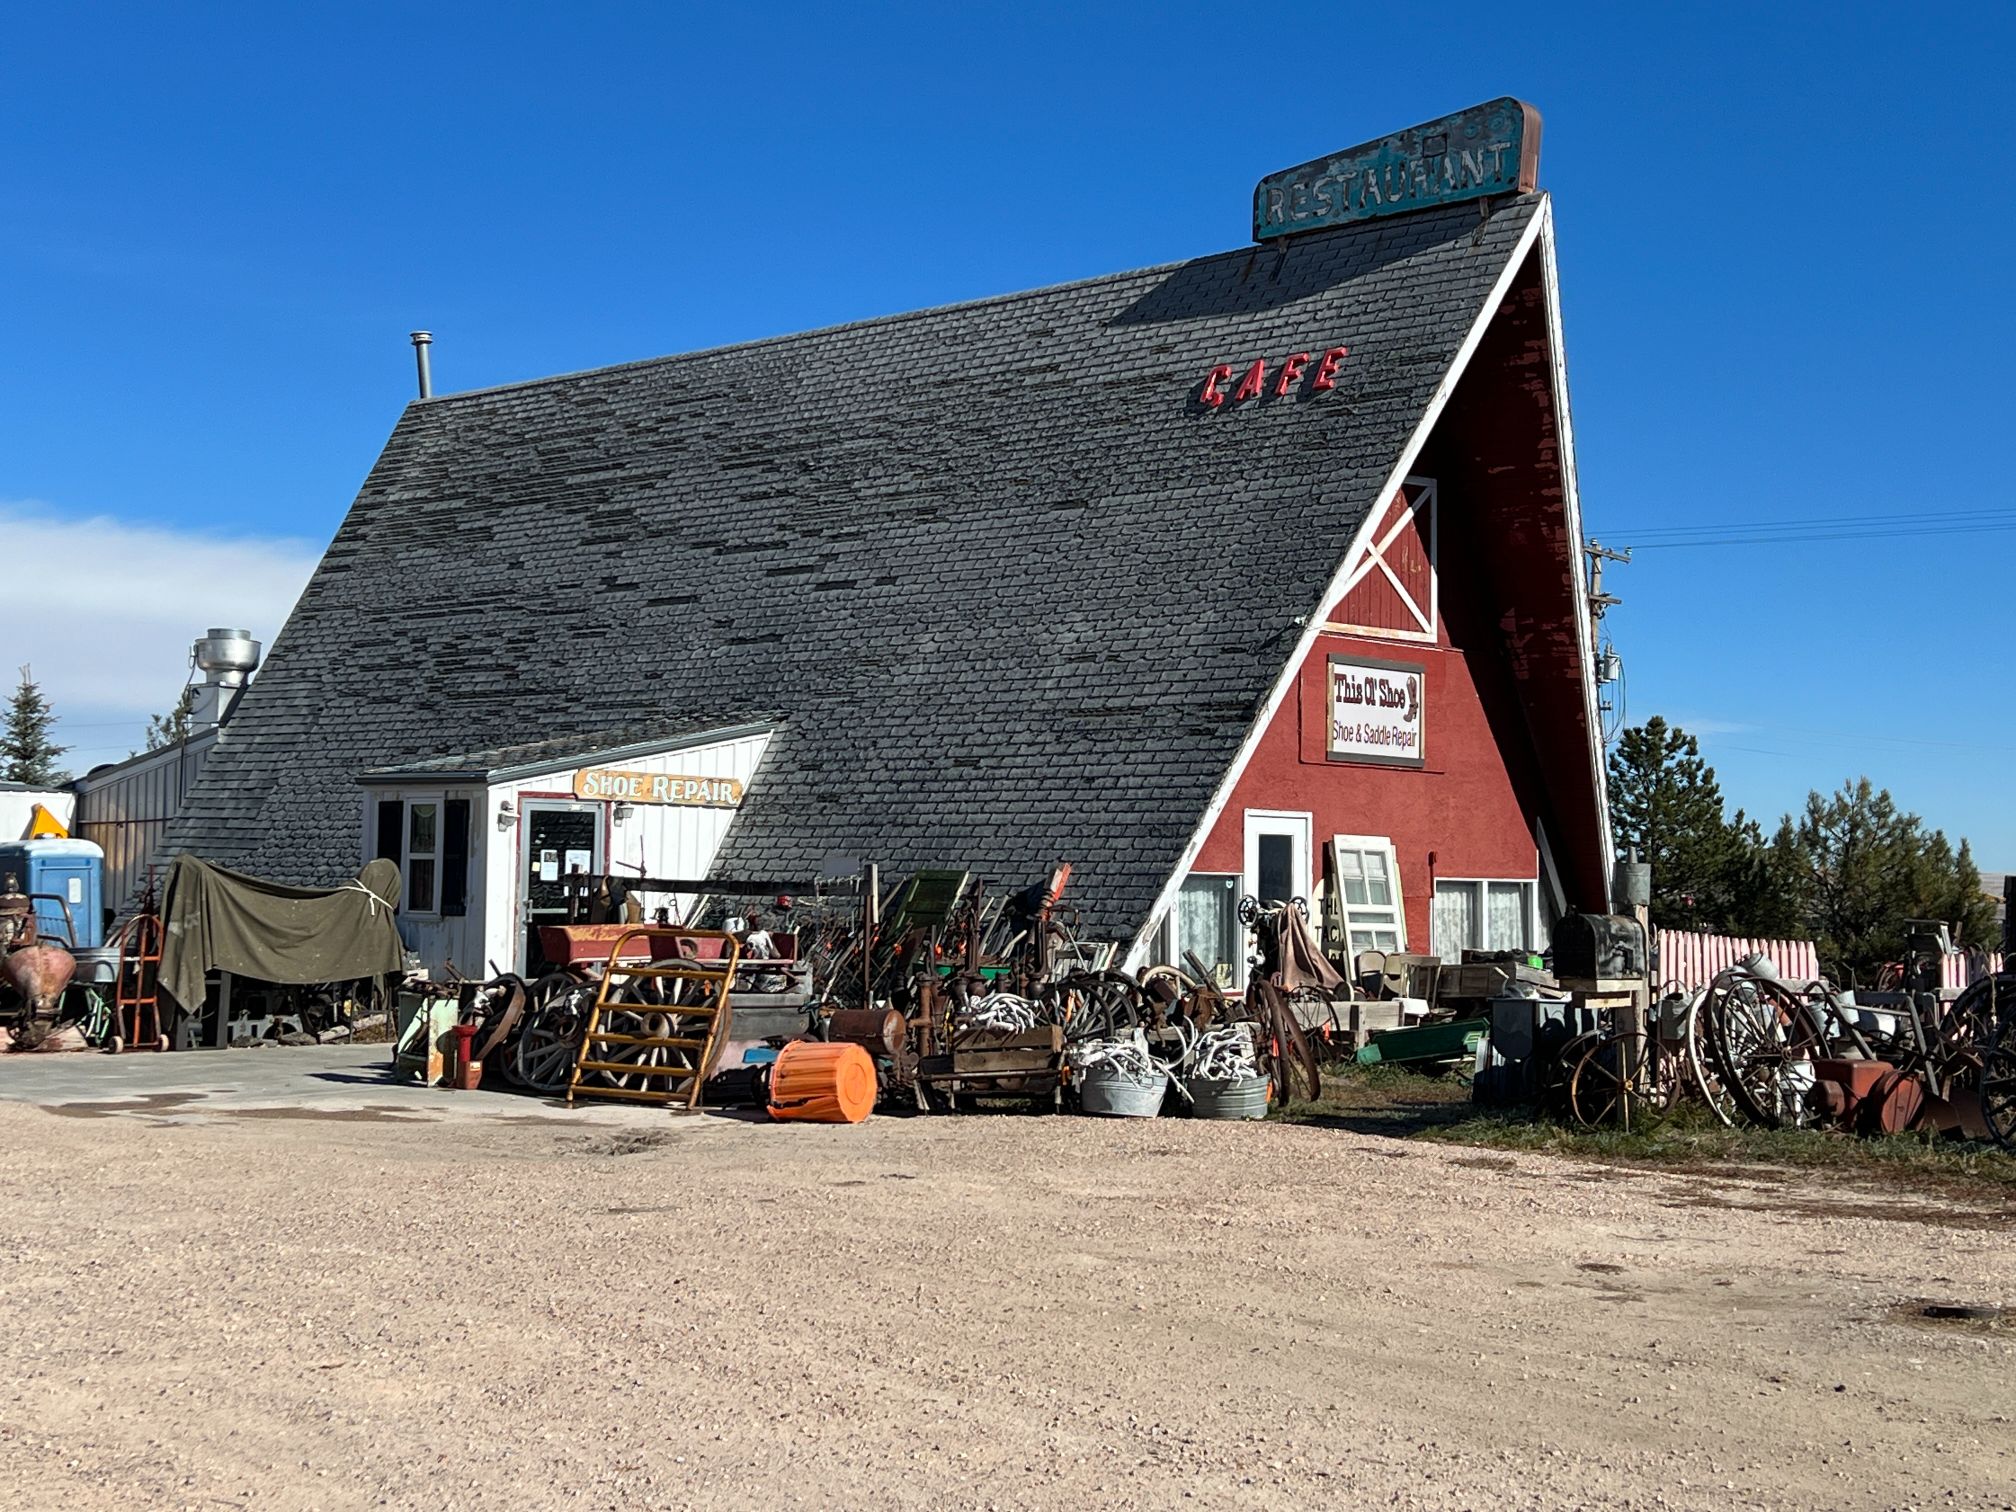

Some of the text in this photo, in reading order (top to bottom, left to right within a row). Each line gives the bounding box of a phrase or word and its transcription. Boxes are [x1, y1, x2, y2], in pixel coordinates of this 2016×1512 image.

[1265, 141, 1512, 226] RESTAURANT
[1200, 346, 1349, 408] CAFE
[1334, 673, 1406, 709] This Ol' Shoe
[1333, 720, 1417, 751] Shoe & Saddle Repair
[583, 772, 739, 804] SHOE REPAIR
[1315, 925, 1341, 943] TAC
